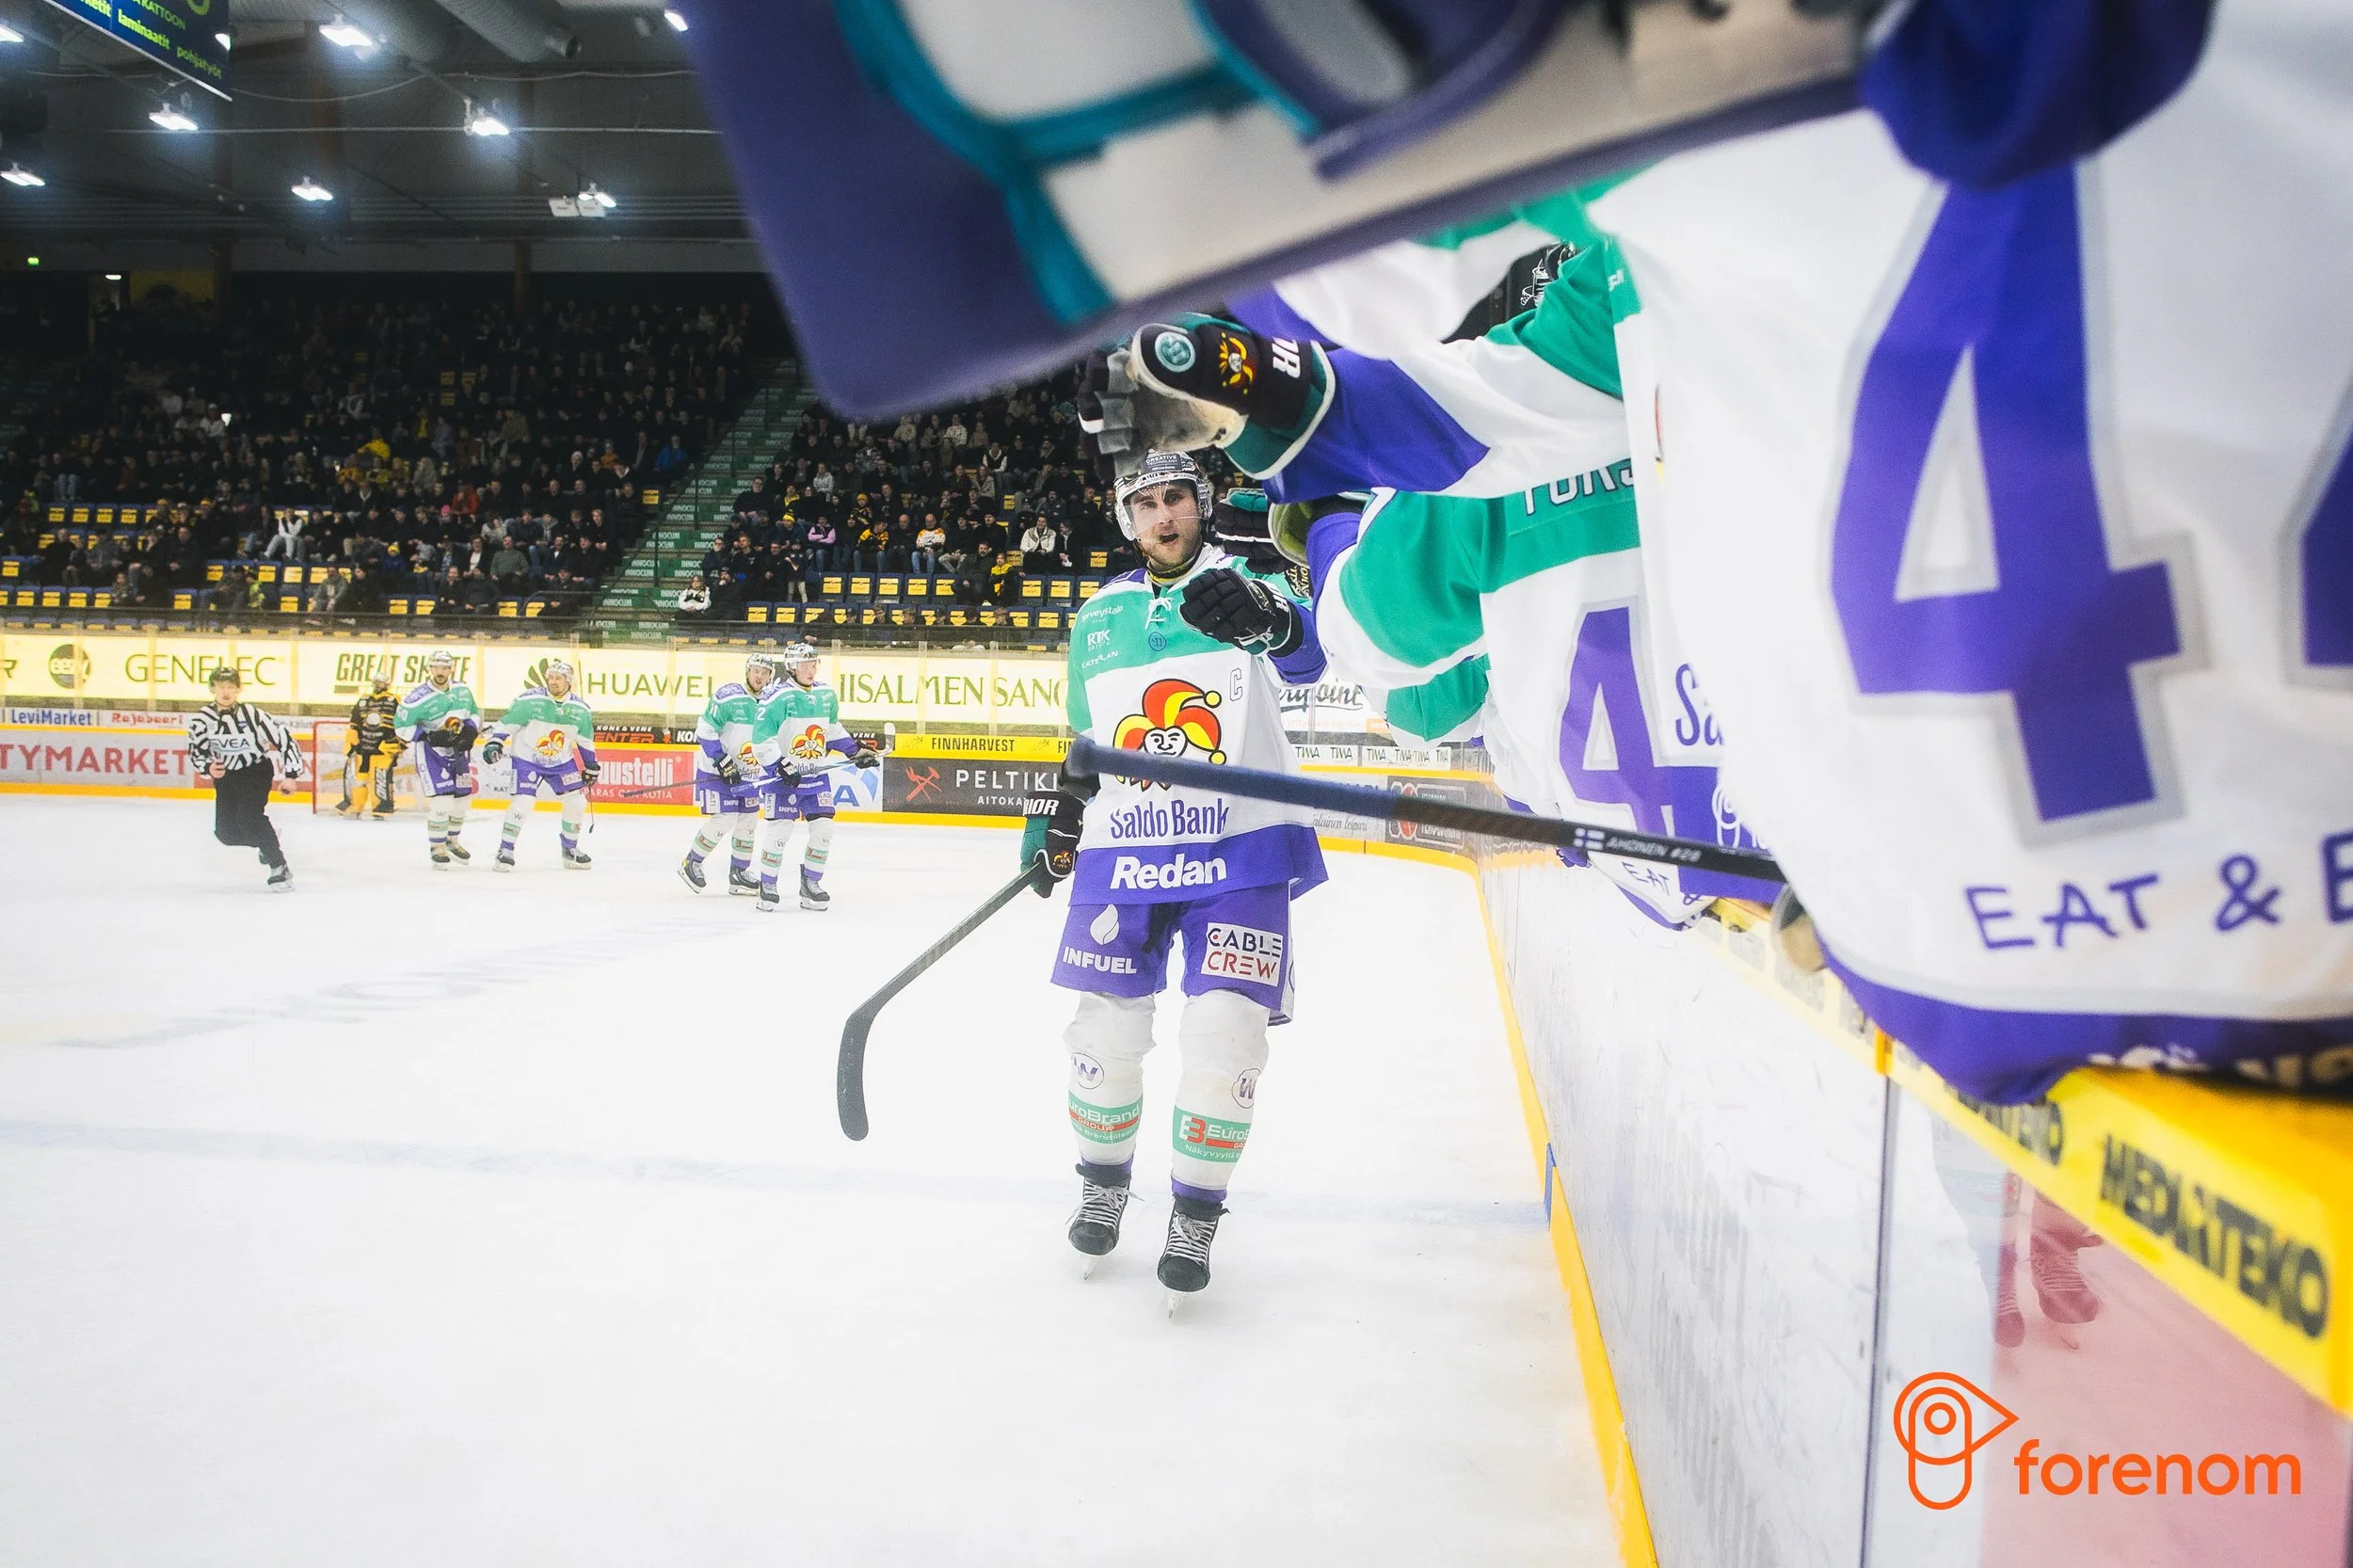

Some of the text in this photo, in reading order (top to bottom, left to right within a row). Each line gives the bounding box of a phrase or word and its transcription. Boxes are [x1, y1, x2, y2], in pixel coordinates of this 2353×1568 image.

[1087, 630, 1112, 646] RTK
[336, 653, 400, 682] GREAT
[1229, 668, 1243, 701] C
[11, 709, 92, 726] LeviMarket
[594, 731, 655, 744] ENTER
[931, 737, 1016, 752] FINNHARVEST
[1110, 797, 1230, 840] Saldo Bank
[1110, 853, 1227, 889] Redan
[1622, 860, 1671, 897] EAT
[1963, 872, 2160, 952] EAT
[2213, 853, 2281, 934] &
[1208, 927, 1283, 958] CABLE
[1062, 945, 1138, 975] INFUEL
[1207, 951, 1278, 980] CREW
